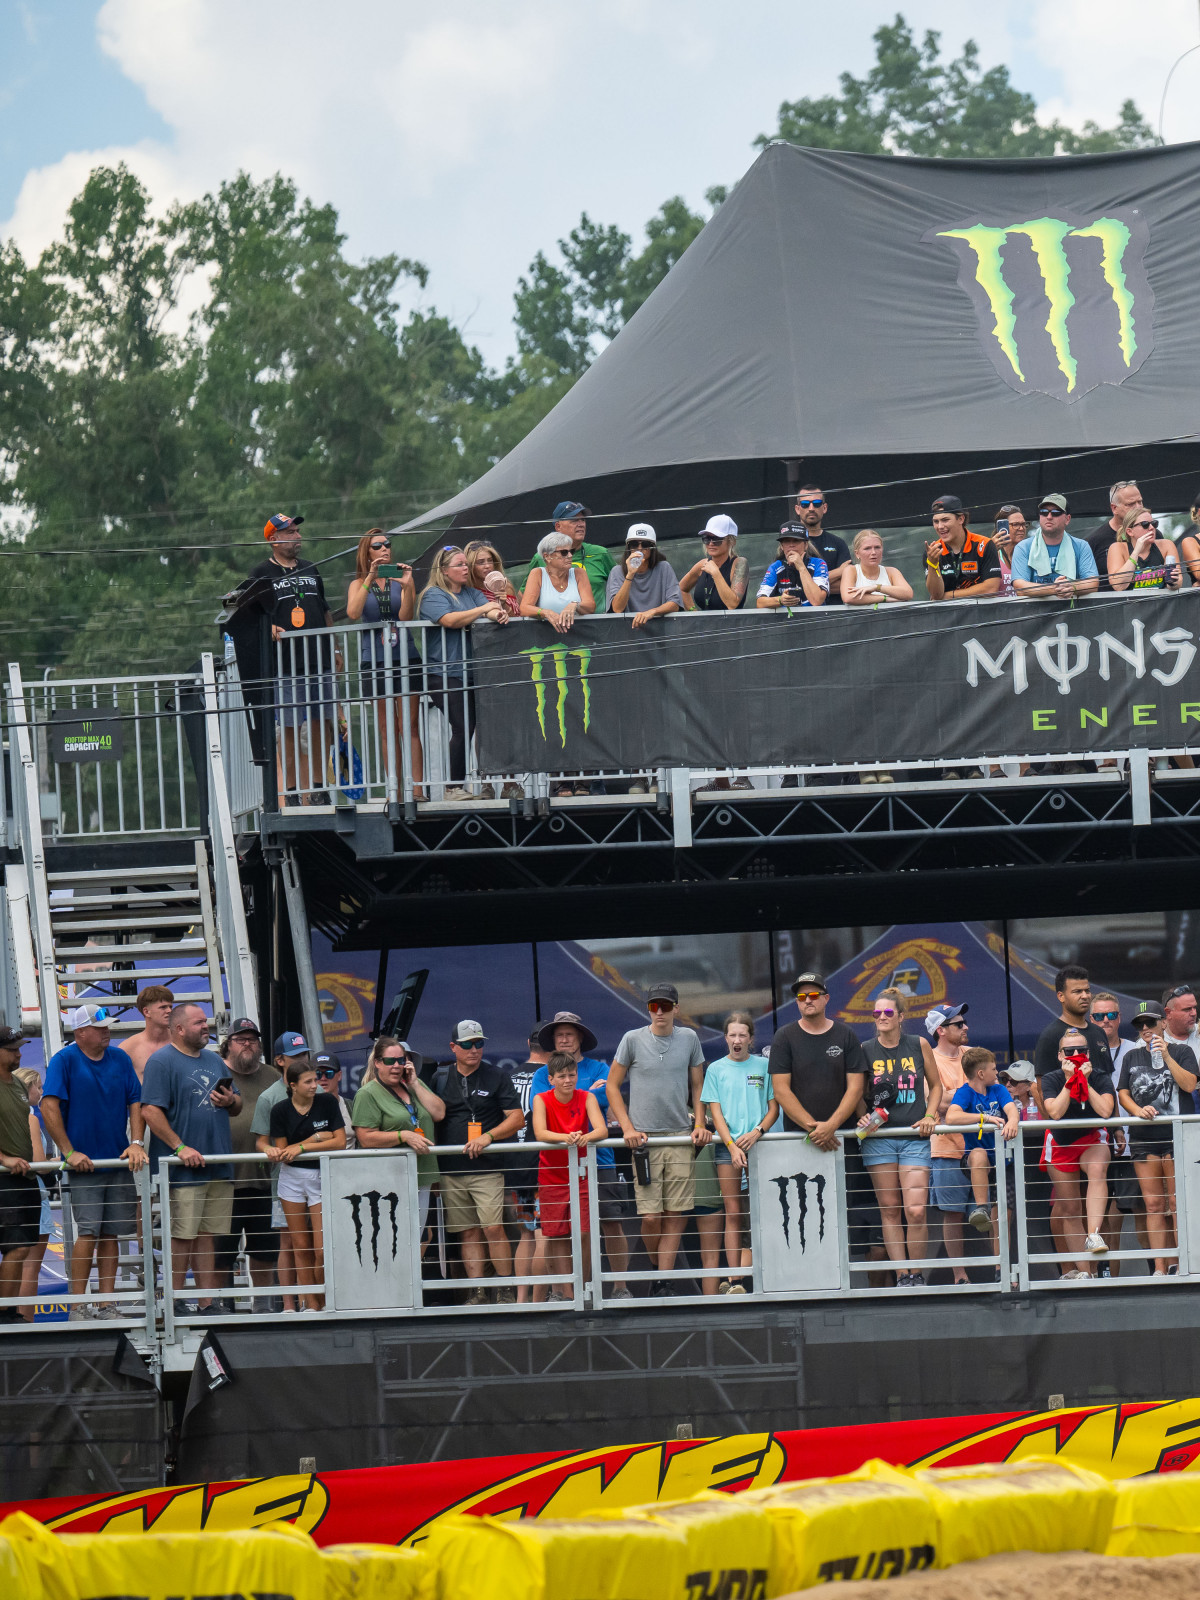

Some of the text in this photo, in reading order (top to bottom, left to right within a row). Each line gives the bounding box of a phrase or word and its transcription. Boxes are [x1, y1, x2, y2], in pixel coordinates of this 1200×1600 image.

[64, 735, 112, 746] ROOFTOP MAX 40
[64, 742, 100, 752] CAPACITY
[896, 1089, 916, 1104] ND
